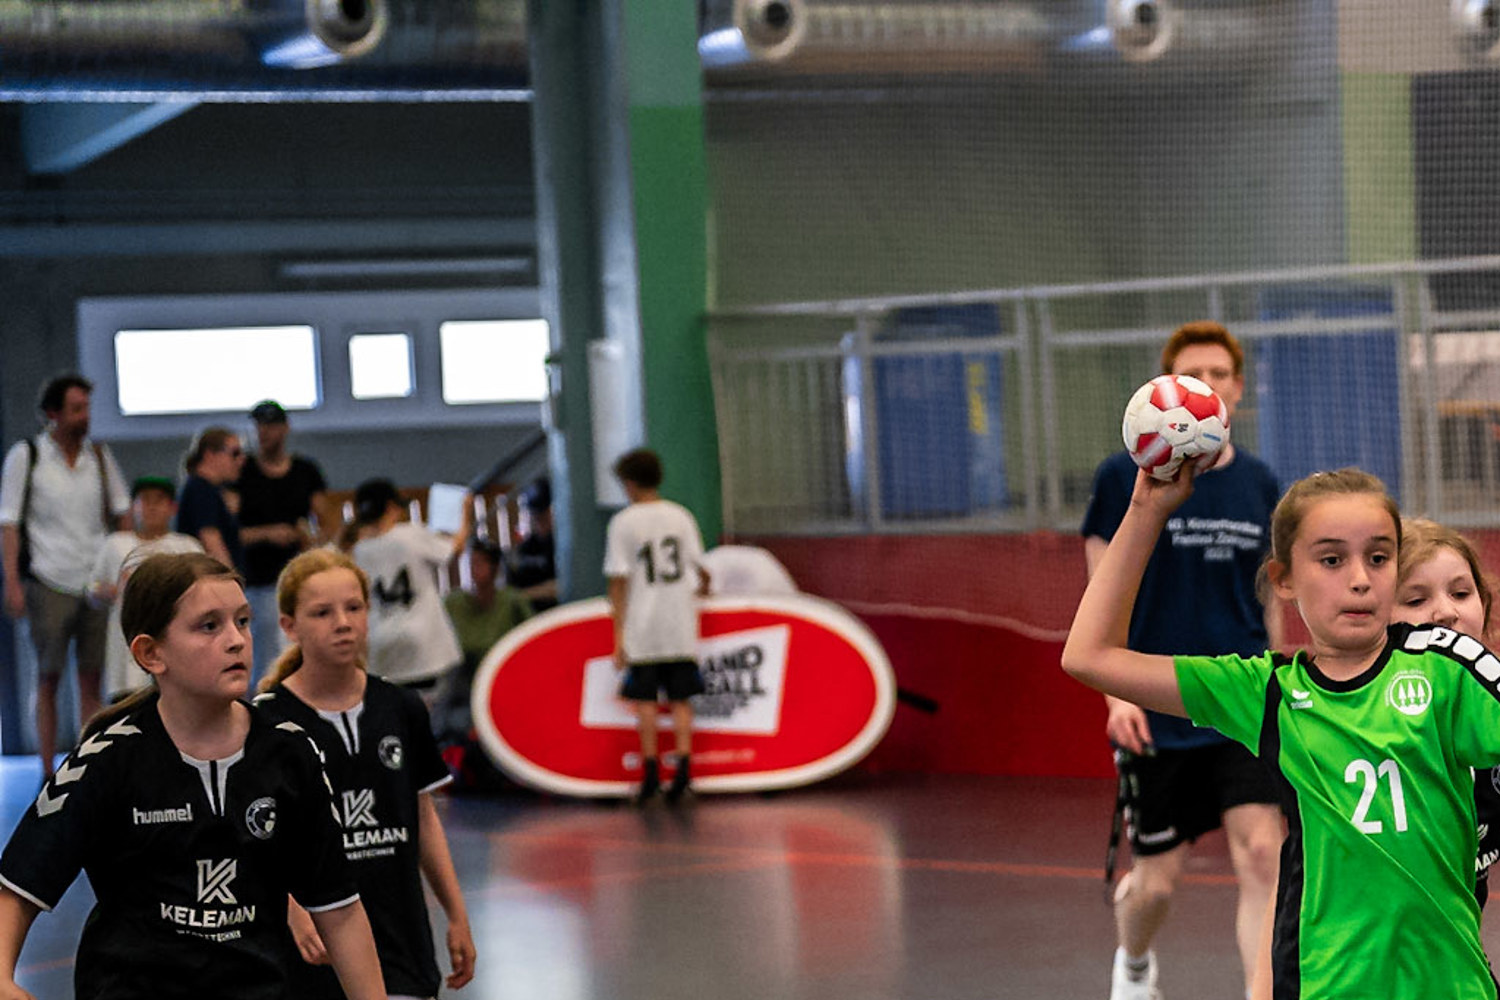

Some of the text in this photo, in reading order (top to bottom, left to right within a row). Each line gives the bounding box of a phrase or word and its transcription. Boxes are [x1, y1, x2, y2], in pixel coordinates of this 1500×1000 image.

[637, 535, 685, 586] 13
[701, 643, 762, 673] AND
[1344, 758, 1408, 834] 21
[132, 802, 193, 825] hummel
[342, 827, 409, 850] LEMAN
[160, 902, 256, 928] KELEMAN
